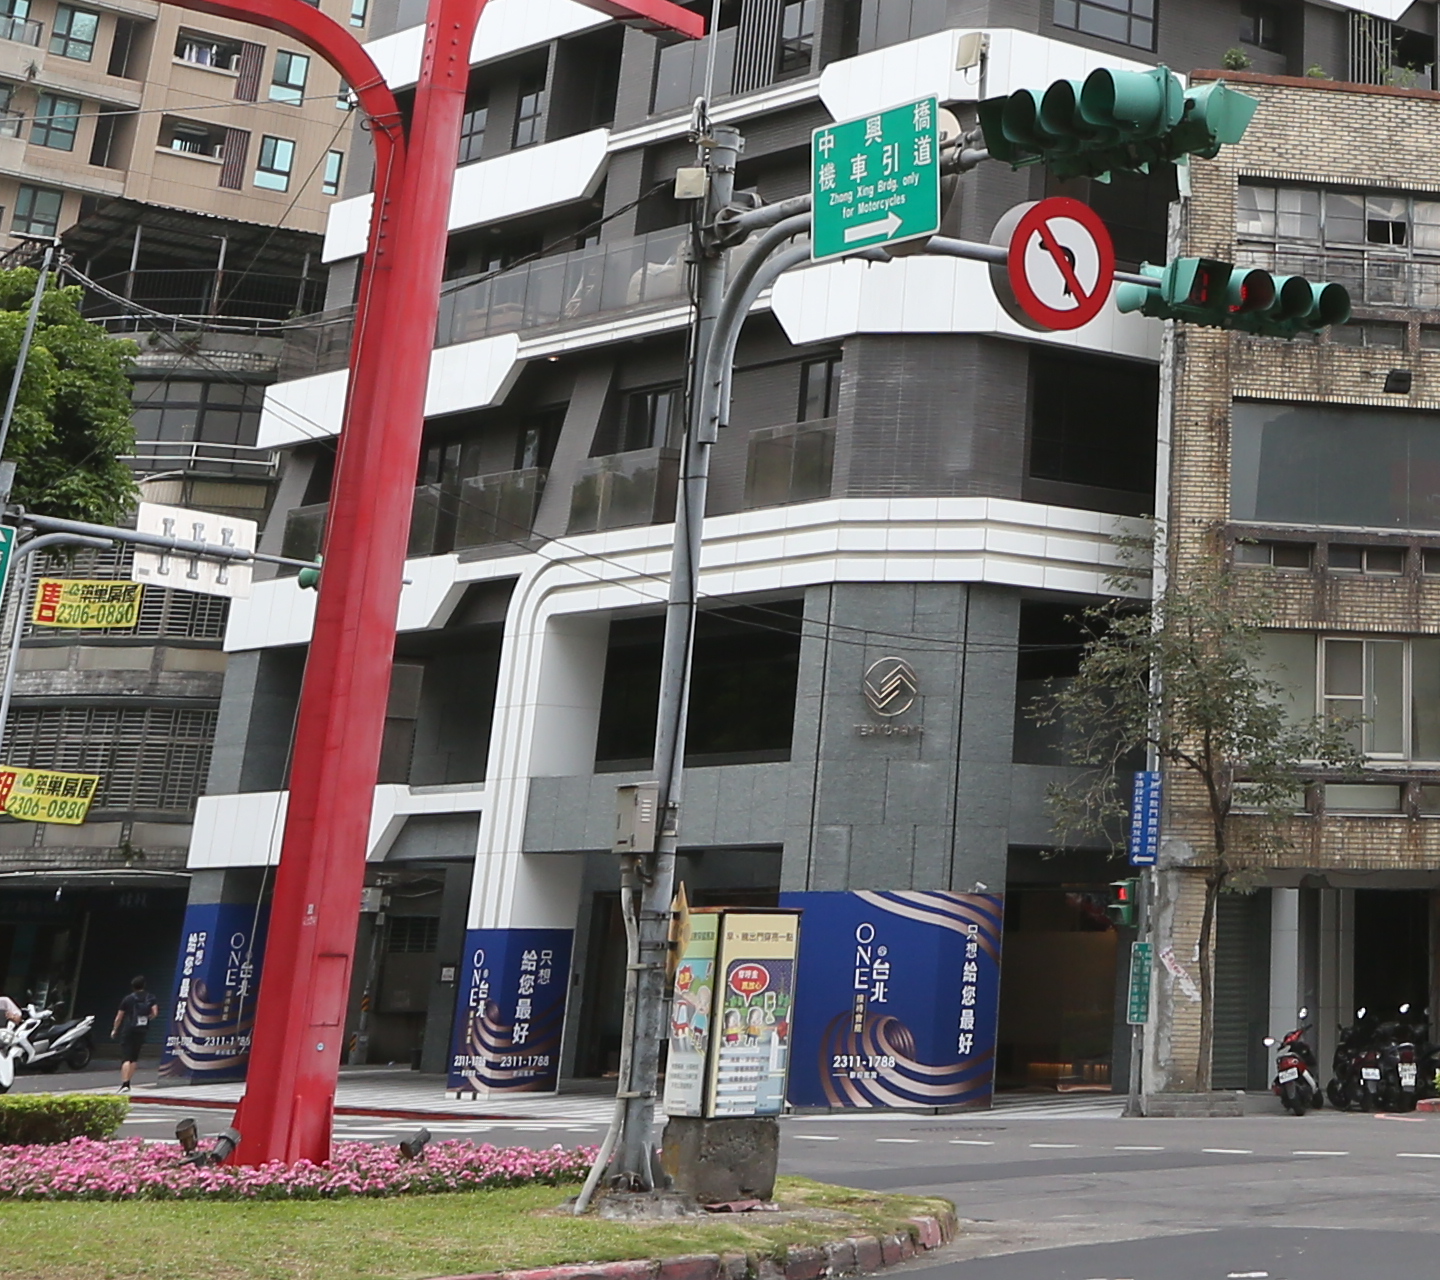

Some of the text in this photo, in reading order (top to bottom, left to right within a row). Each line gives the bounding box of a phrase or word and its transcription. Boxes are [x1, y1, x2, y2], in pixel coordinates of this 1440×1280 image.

[819, 101, 931, 159] 中興橋
[819, 135, 932, 192] 機車引道
[857, 184, 874, 198] Xing
[902, 172, 920, 186] only
[842, 193, 906, 219] for Motorcycles
[37, 582, 63, 622] 售
[56, 603, 135, 624] 2306-0880
[7, 795, 85, 819] 2306-0880
[225, 932, 245, 986] ONE
[537, 950, 553, 984] 只想
[854, 923, 875, 990] ONE
[469, 949, 485, 1006] ONE
[512, 949, 538, 1044] 給您最好
[870, 959, 890, 1003] 台北
[958, 924, 979, 1055] 只想給您最好
[476, 980, 489, 1018] 台北
[500, 1055, 549, 1067] 2311-1788
[833, 1055, 895, 1068] 2311-1788
